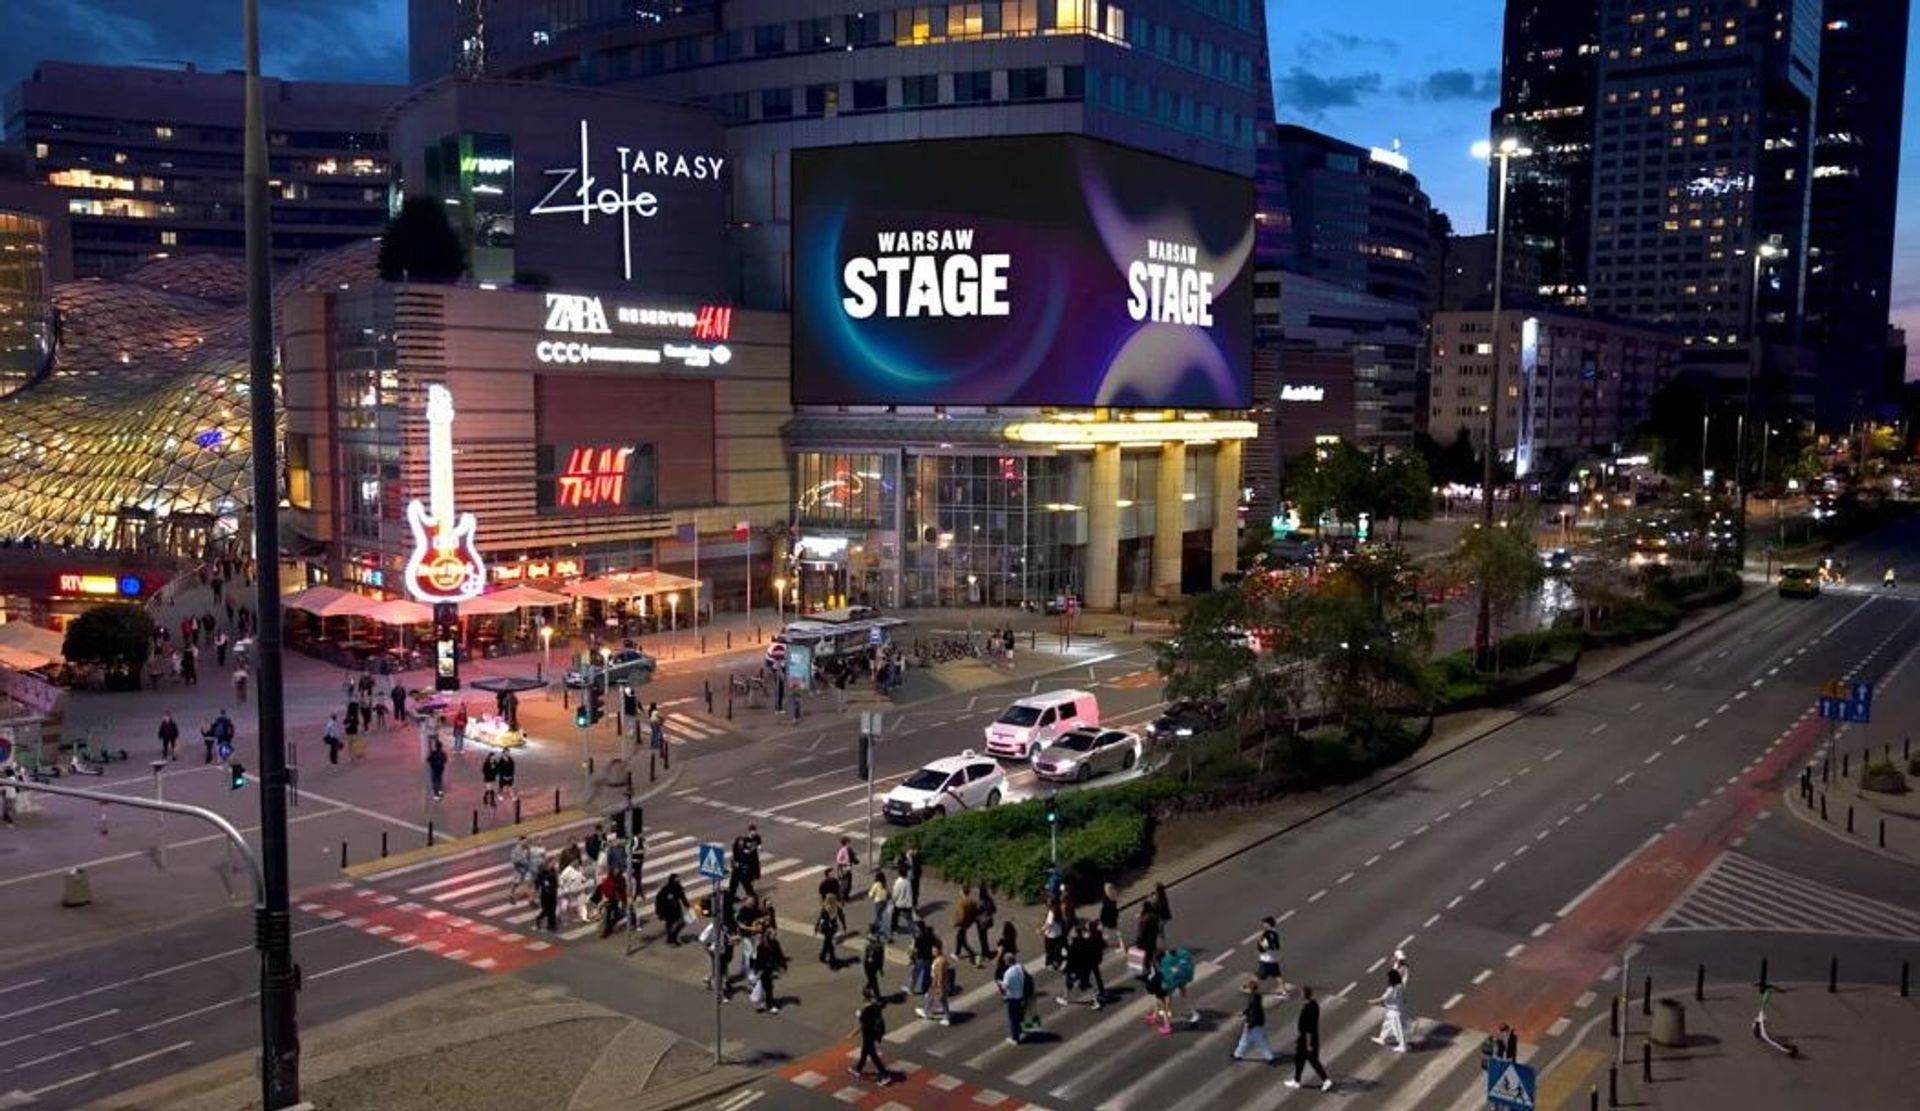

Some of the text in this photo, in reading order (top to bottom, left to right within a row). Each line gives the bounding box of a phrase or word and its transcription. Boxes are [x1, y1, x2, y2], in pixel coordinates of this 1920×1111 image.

[617, 147, 723, 179] TARASY
[878, 229, 974, 253] WARSAW
[1147, 239, 1197, 265] WARSAW
[843, 254, 1010, 319] STAGE
[1127, 262, 1214, 327] STAGE
[545, 293, 612, 333] ZARA
[618, 307, 696, 327] RESERVED
[536, 341, 581, 363] CCC
[560, 448, 628, 507] H&M
